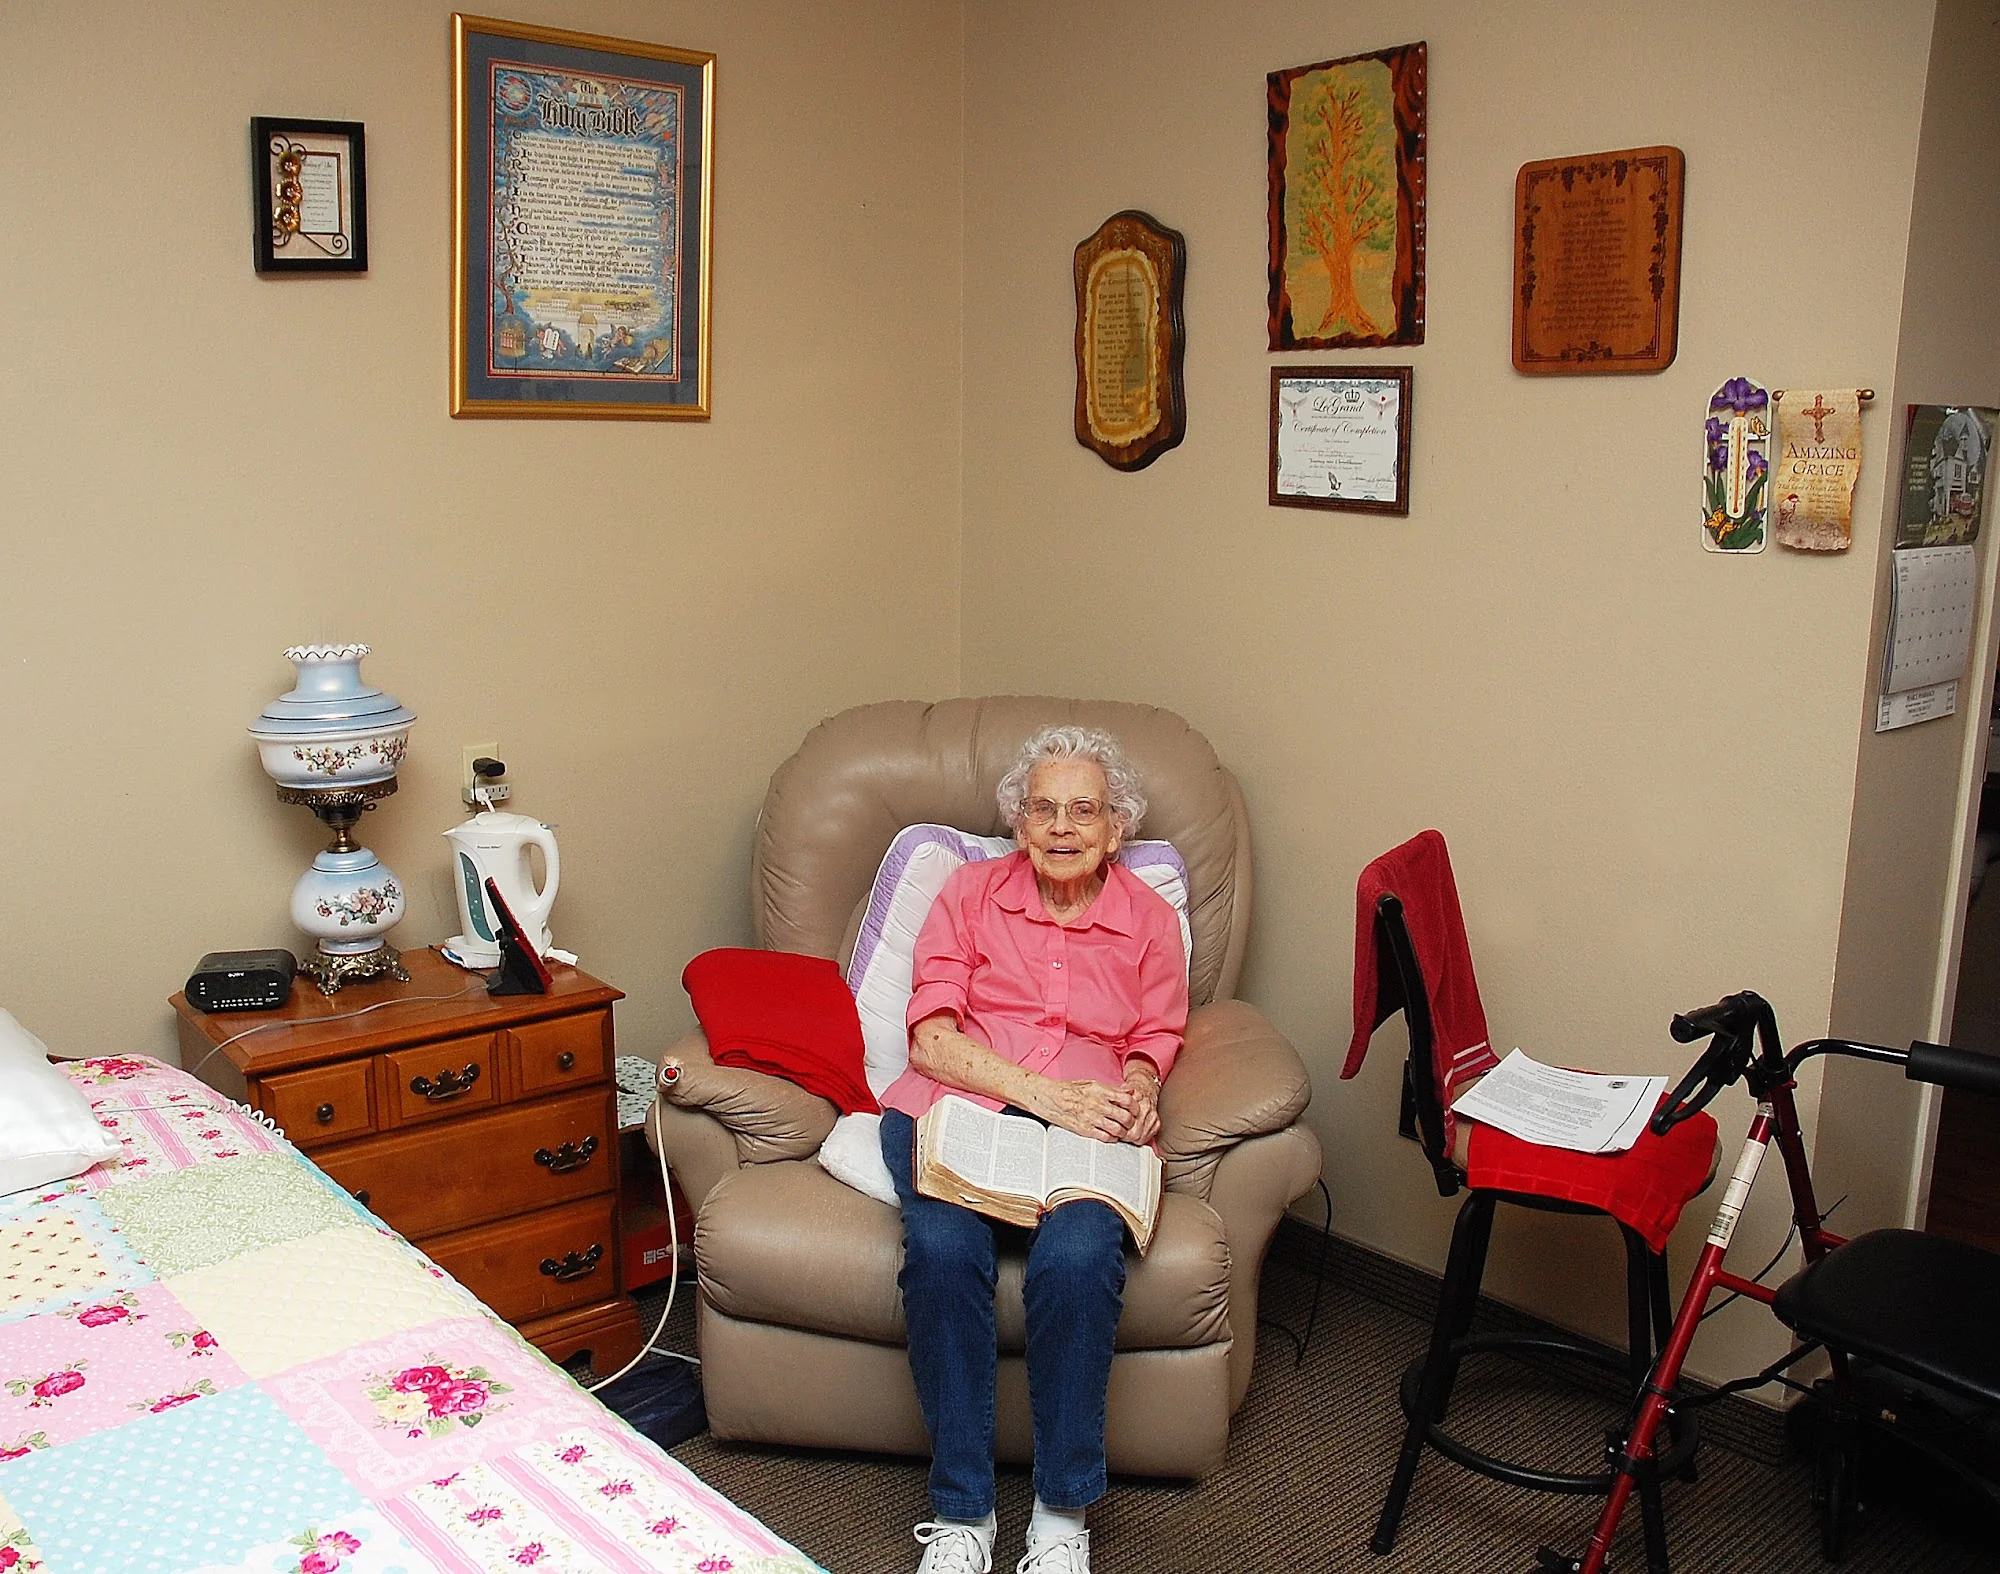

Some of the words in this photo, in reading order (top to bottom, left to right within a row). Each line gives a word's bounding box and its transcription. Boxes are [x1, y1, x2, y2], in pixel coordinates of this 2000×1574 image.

[580, 80, 599, 95] The
[537, 94, 588, 137] Holy
[1342, 421, 1386, 438] Completion
[1787, 442, 1856, 460] AMAZING
[1792, 460, 1844, 476] GRACE
